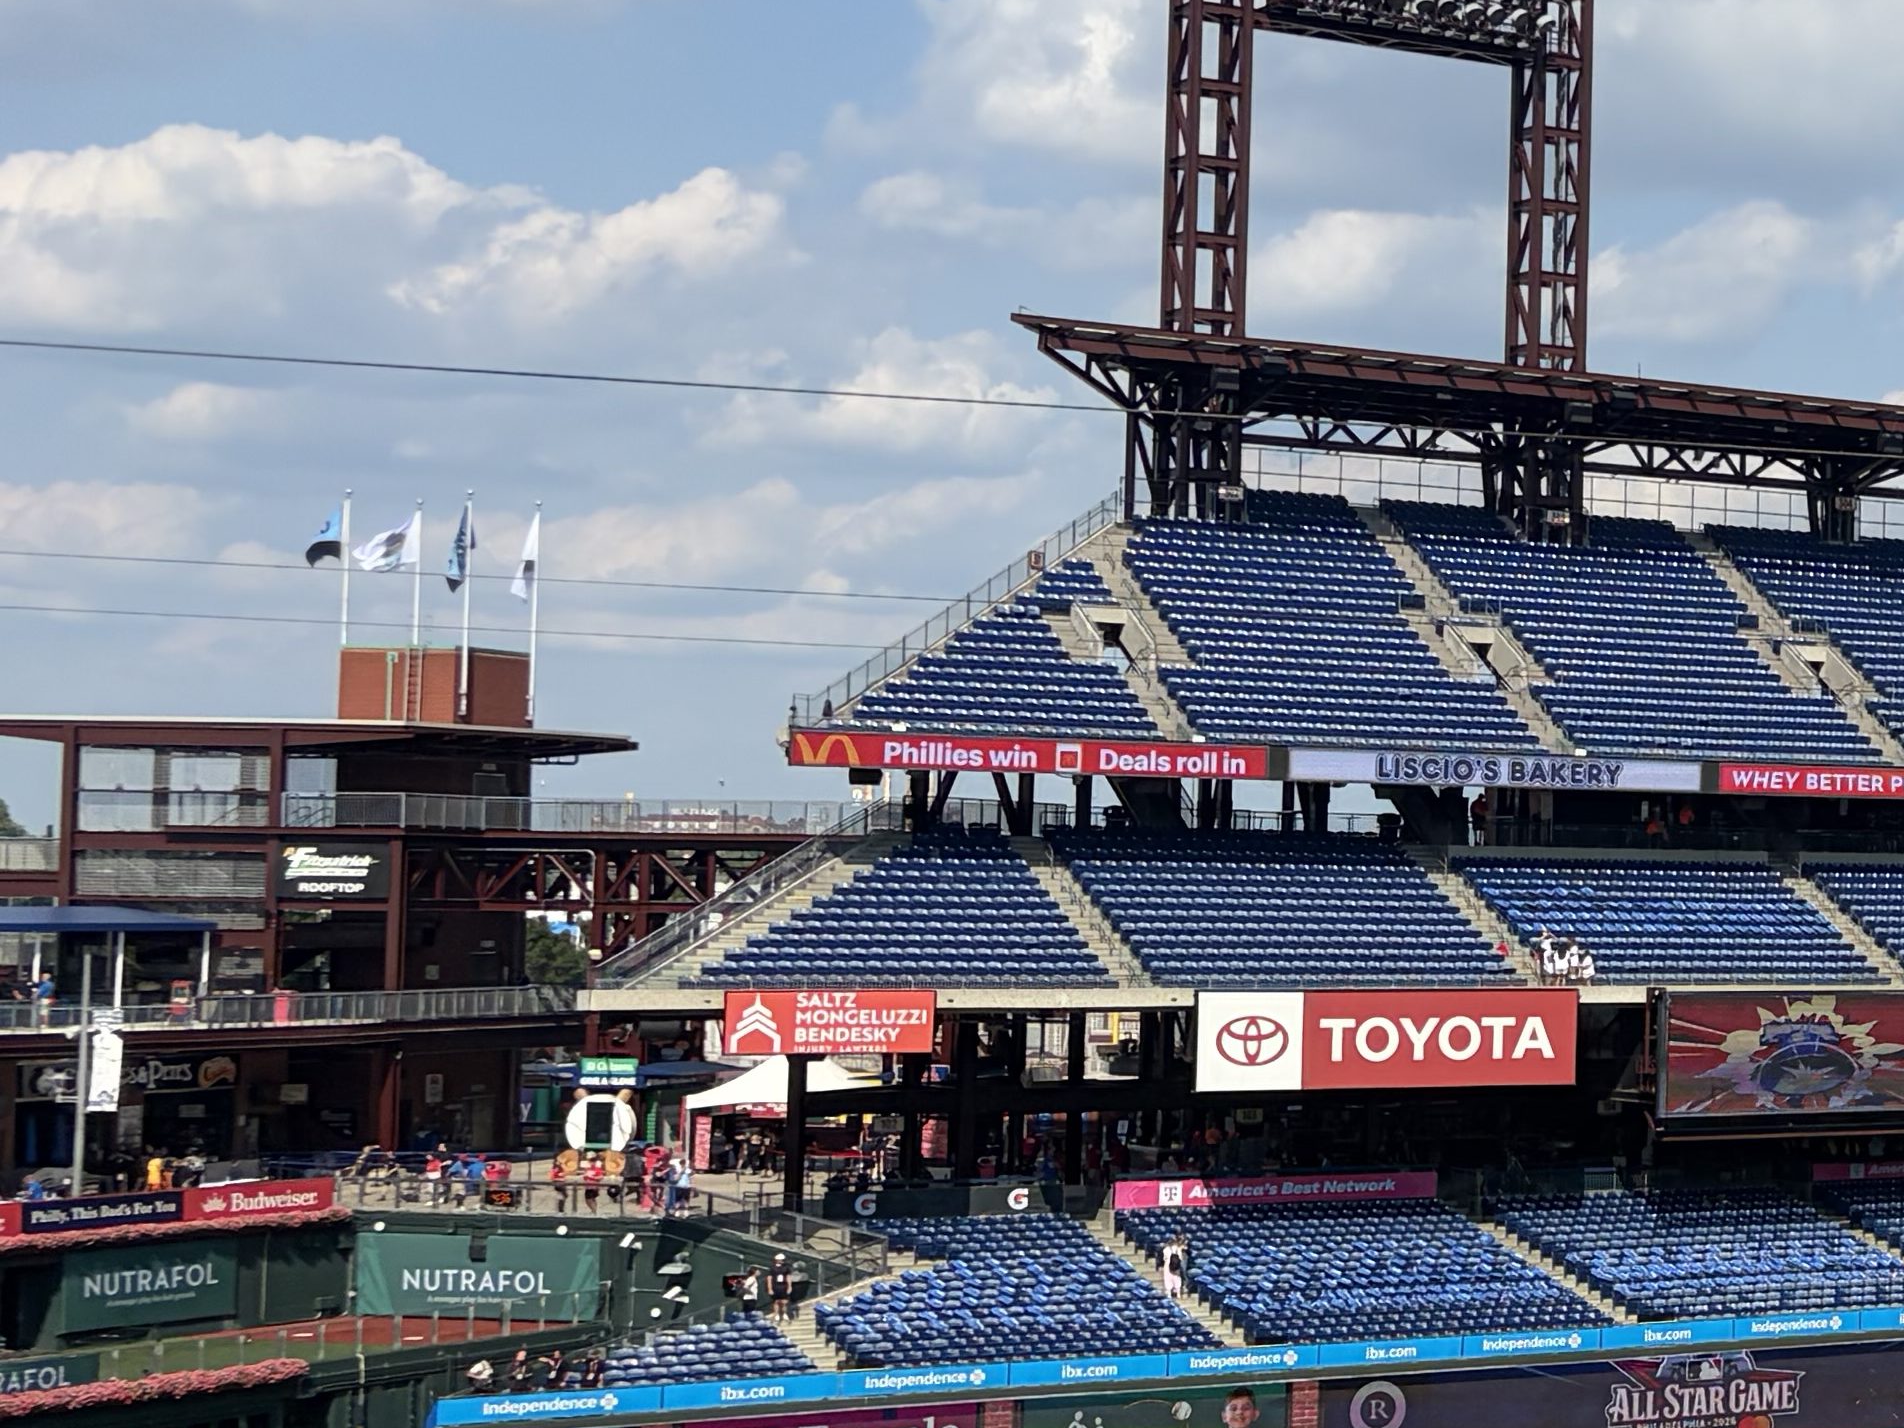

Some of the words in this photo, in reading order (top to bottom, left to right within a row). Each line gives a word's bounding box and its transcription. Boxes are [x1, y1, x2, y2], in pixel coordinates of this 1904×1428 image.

[883, 739, 984, 767] Phillies
[989, 744, 1037, 768] win
[1099, 747, 1170, 773] Deals
[1176, 751, 1218, 774] roll
[1222, 752, 1246, 775] in
[1375, 753, 1500, 783] LISCIO'S
[1507, 756, 1624, 787] BAKERY
[1732, 770, 1801, 790] WHEY
[1806, 773, 1885, 792] BETTER
[298, 882, 366, 893] ROOFTOP
[796, 992, 857, 1007] SALTZ
[794, 1009, 927, 1024] MONGELUZZI
[794, 1027, 901, 1042] BENDESKY
[1319, 1015, 1556, 1062] TOYOTA
[1188, 1182, 1278, 1200] America's
[1281, 1181, 1320, 1194] Best
[1323, 1178, 1396, 1193] Network
[229, 1189, 318, 1213] Budweiser
[31, 1210, 70, 1224] Philly,
[72, 1206, 99, 1220] This
[100, 1204, 132, 1218] Bud's
[134, 1203, 153, 1215] For
[154, 1201, 177, 1213] You
[83, 1262, 219, 1298] NUTRAFOL
[402, 1268, 551, 1295] NUTRAFOL
[1643, 1327, 1692, 1343] ibx.com
[1751, 1317, 1829, 1334] Independence
[1364, 1343, 1418, 1361] ibx.com
[1481, 1334, 1567, 1352] Independence
[1188, 1350, 1281, 1370] Independence
[864, 1368, 969, 1390] Independence
[1060, 1363, 1119, 1380] ibx.com
[720, 1384, 785, 1401] ibx.com
[1608, 1386, 1660, 1423] ALL
[1663, 1382, 1726, 1419] STAR
[1728, 1378, 1796, 1413] GAME
[483, 1395, 598, 1417] Independence
